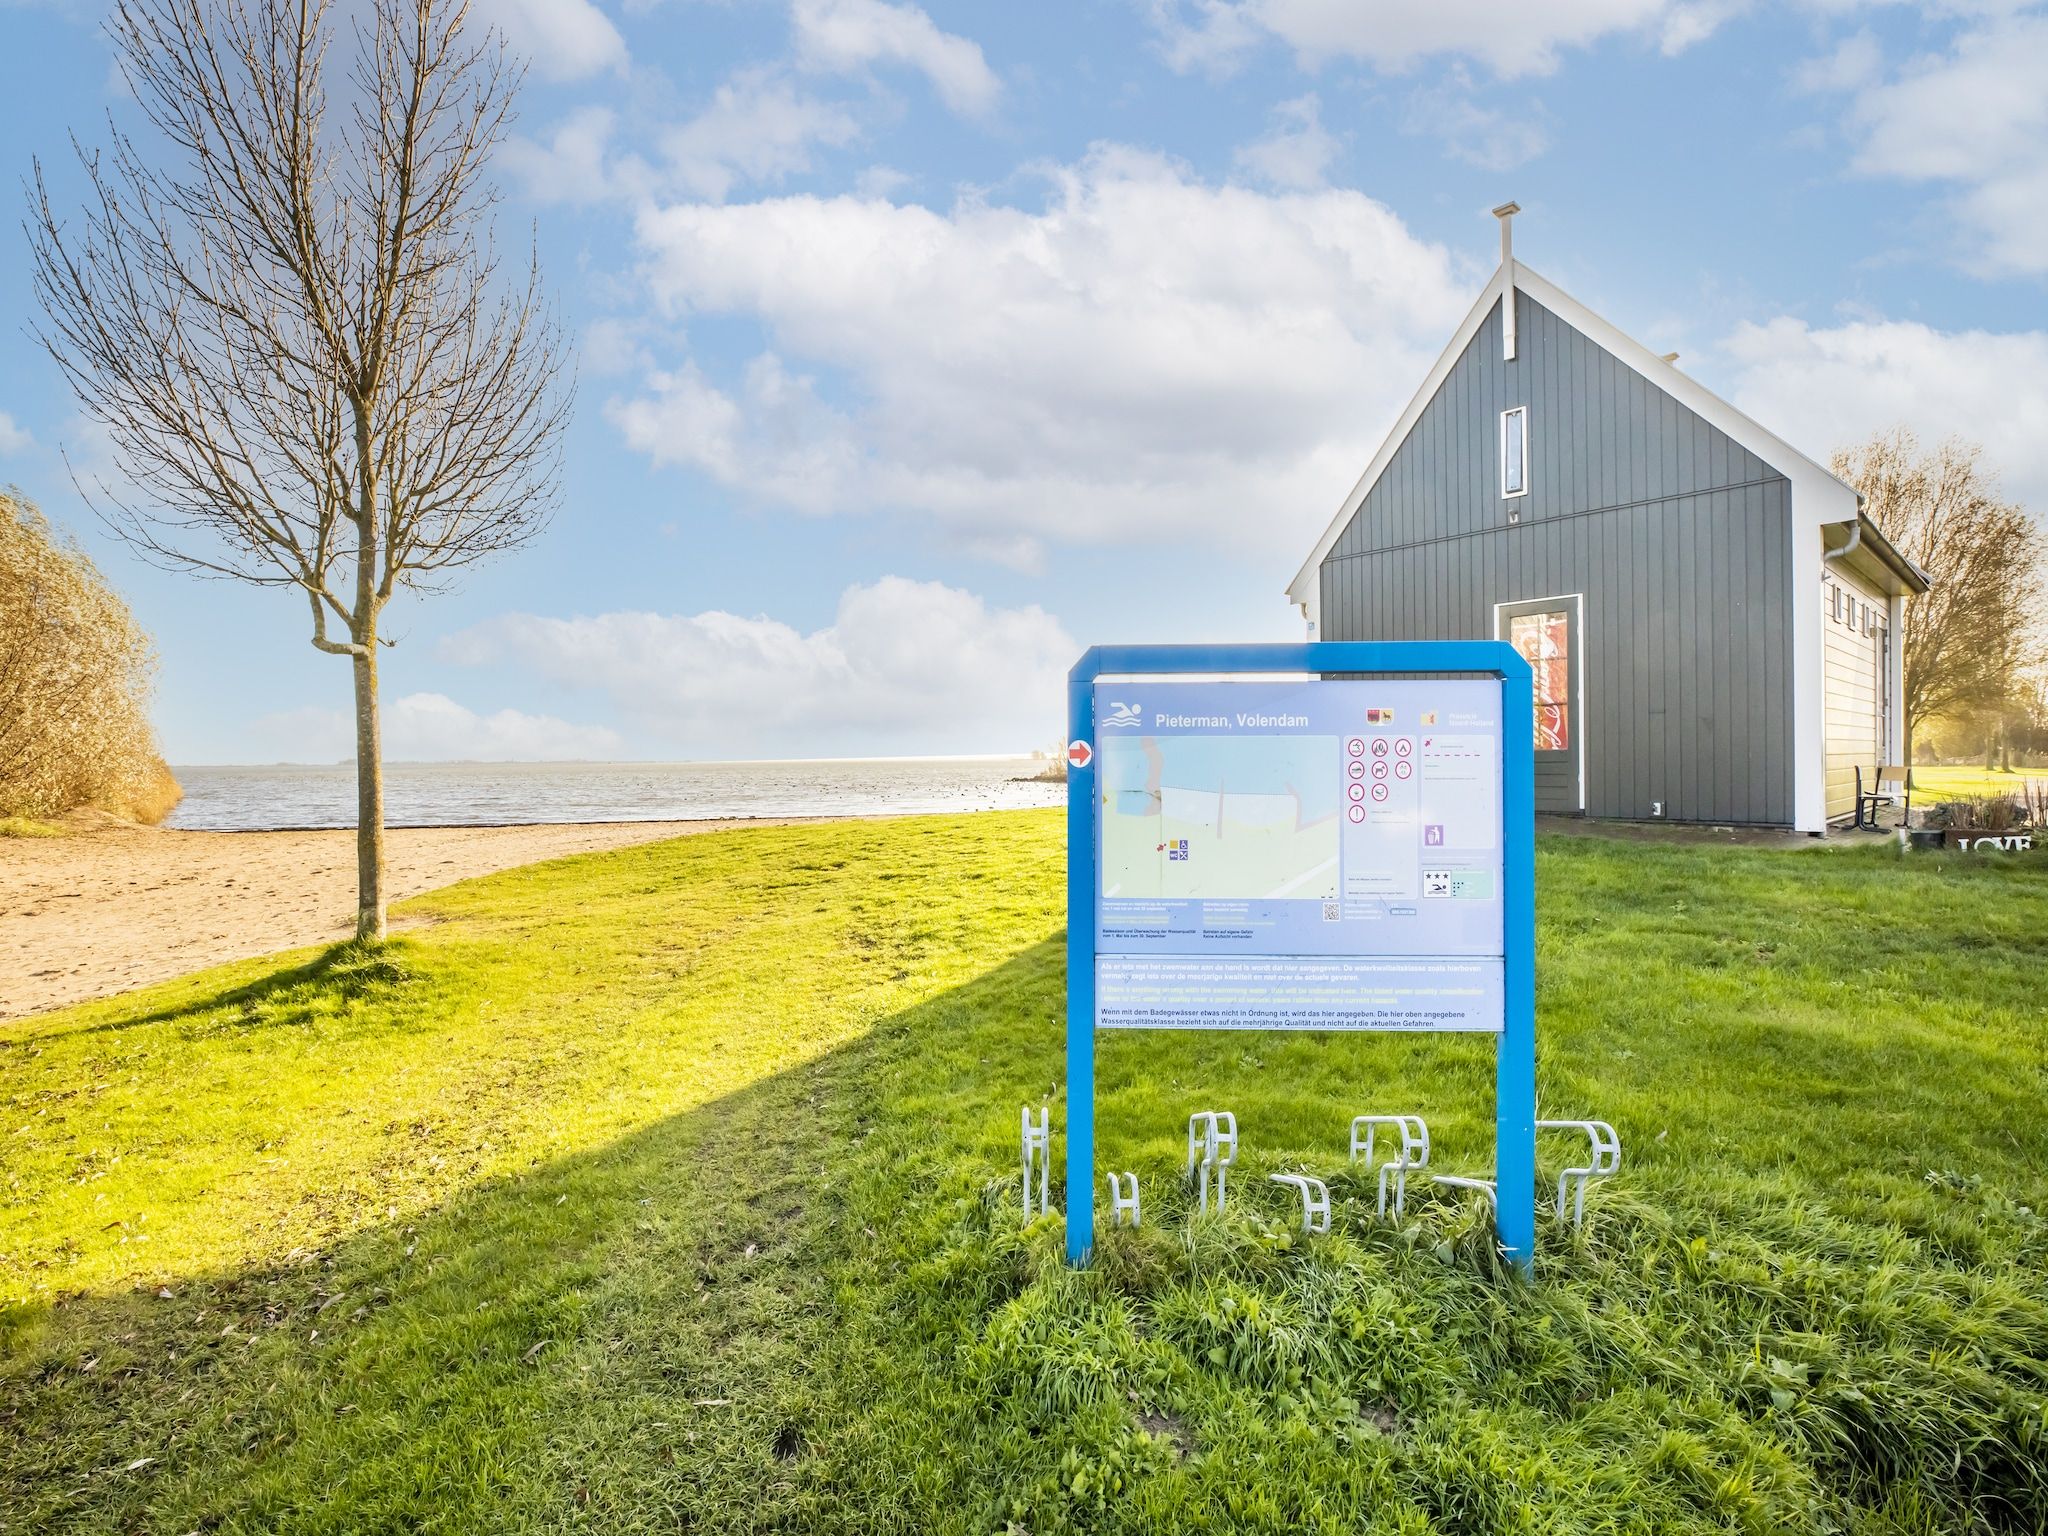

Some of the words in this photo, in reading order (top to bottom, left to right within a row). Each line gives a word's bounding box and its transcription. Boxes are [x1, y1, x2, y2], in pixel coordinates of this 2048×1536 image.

[1156, 714, 1232, 728] Pieterman,
[1237, 713, 1308, 727] Volendam
[1150, 1009, 1198, 1017] Badegewässer
[1248, 1009, 1278, 1018] Ordnung
[1279, 1010, 1290, 1018] ist,
[1336, 1010, 1376, 1018] angegeben.
[1424, 1010, 1465, 1019] angegebene
[1101, 1018, 1176, 1027] Wasserqualitätsklasse
[1242, 1019, 1283, 1027] mehrjährige
[1284, 1019, 1311, 1027] Qualität
